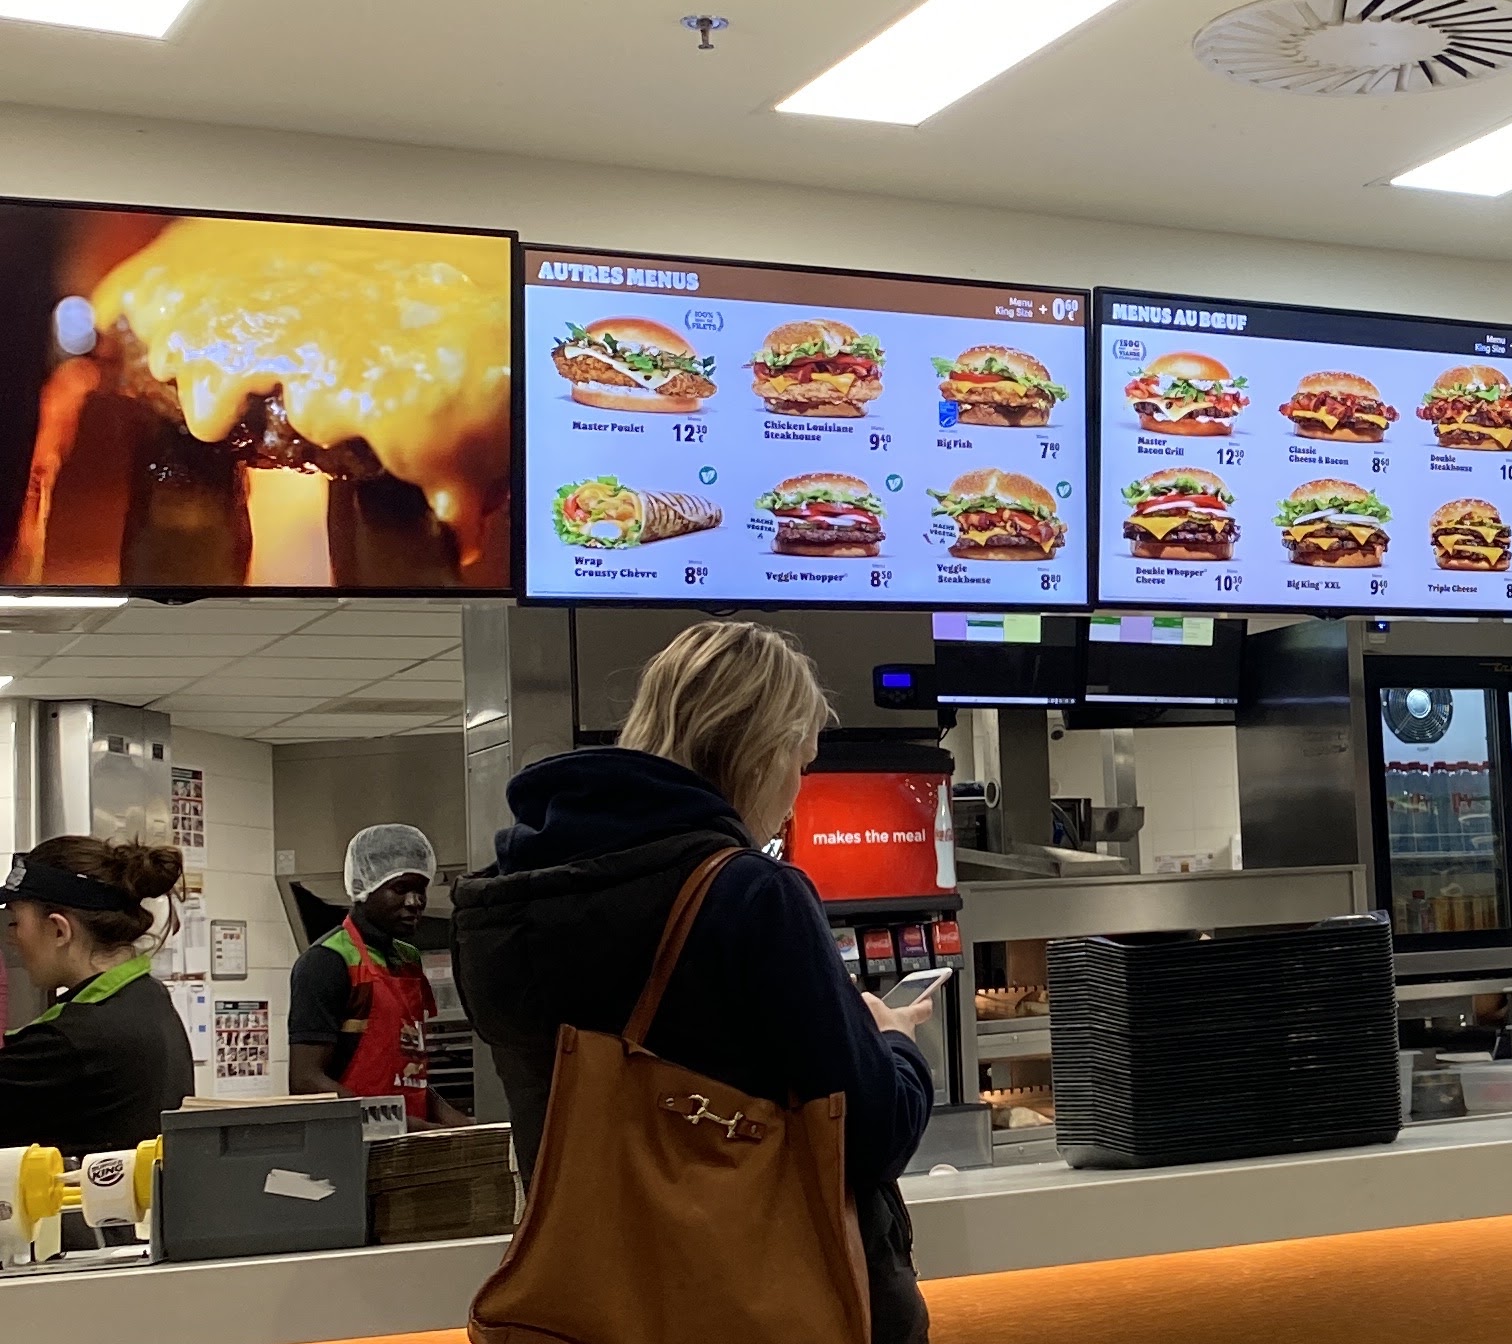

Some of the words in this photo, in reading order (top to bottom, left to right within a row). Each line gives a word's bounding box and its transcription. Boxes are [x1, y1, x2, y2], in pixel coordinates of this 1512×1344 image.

[538, 261, 624, 285] AUTRES
[626, 267, 700, 291] MENUS
[1009, 297, 1033, 308] Menu
[995, 305, 1015, 318] King
[1016, 307, 1033, 318] Size
[1112, 303, 1172, 324] MENUS
[1173, 309, 1197, 327] AU
[1198, 312, 1247, 331] BŒUF
[572, 421, 609, 432] Master
[610, 422, 644, 433] Poulet
[764, 420, 805, 432] Chicken
[806, 422, 854, 433] Louisiane
[764, 431, 822, 441] Steakhouse
[937, 439, 952, 449] Big
[953, 439, 973, 449] Fish
[1138, 437, 1167, 446] Master
[1137, 446, 1163, 455] Bacon
[1165, 447, 1184, 456] Grill
[1288, 446, 1316, 455] Classic
[1288, 455, 1317, 464] Cheese
[574, 556, 603, 566] Wrap
[574, 568, 618, 579] Crousty
[620, 567, 657, 579] Chèvre
[937, 563, 967, 574] Veggie
[1136, 567, 1166, 576] Double
[766, 571, 798, 582] Veggie
[937, 575, 991, 585] Steakhouse
[1136, 576, 1166, 585] Cheese
[1287, 580, 1300, 589] Big
[813, 830, 861, 845] makes
[865, 829, 889, 843] the
[893, 828, 926, 843] meal
